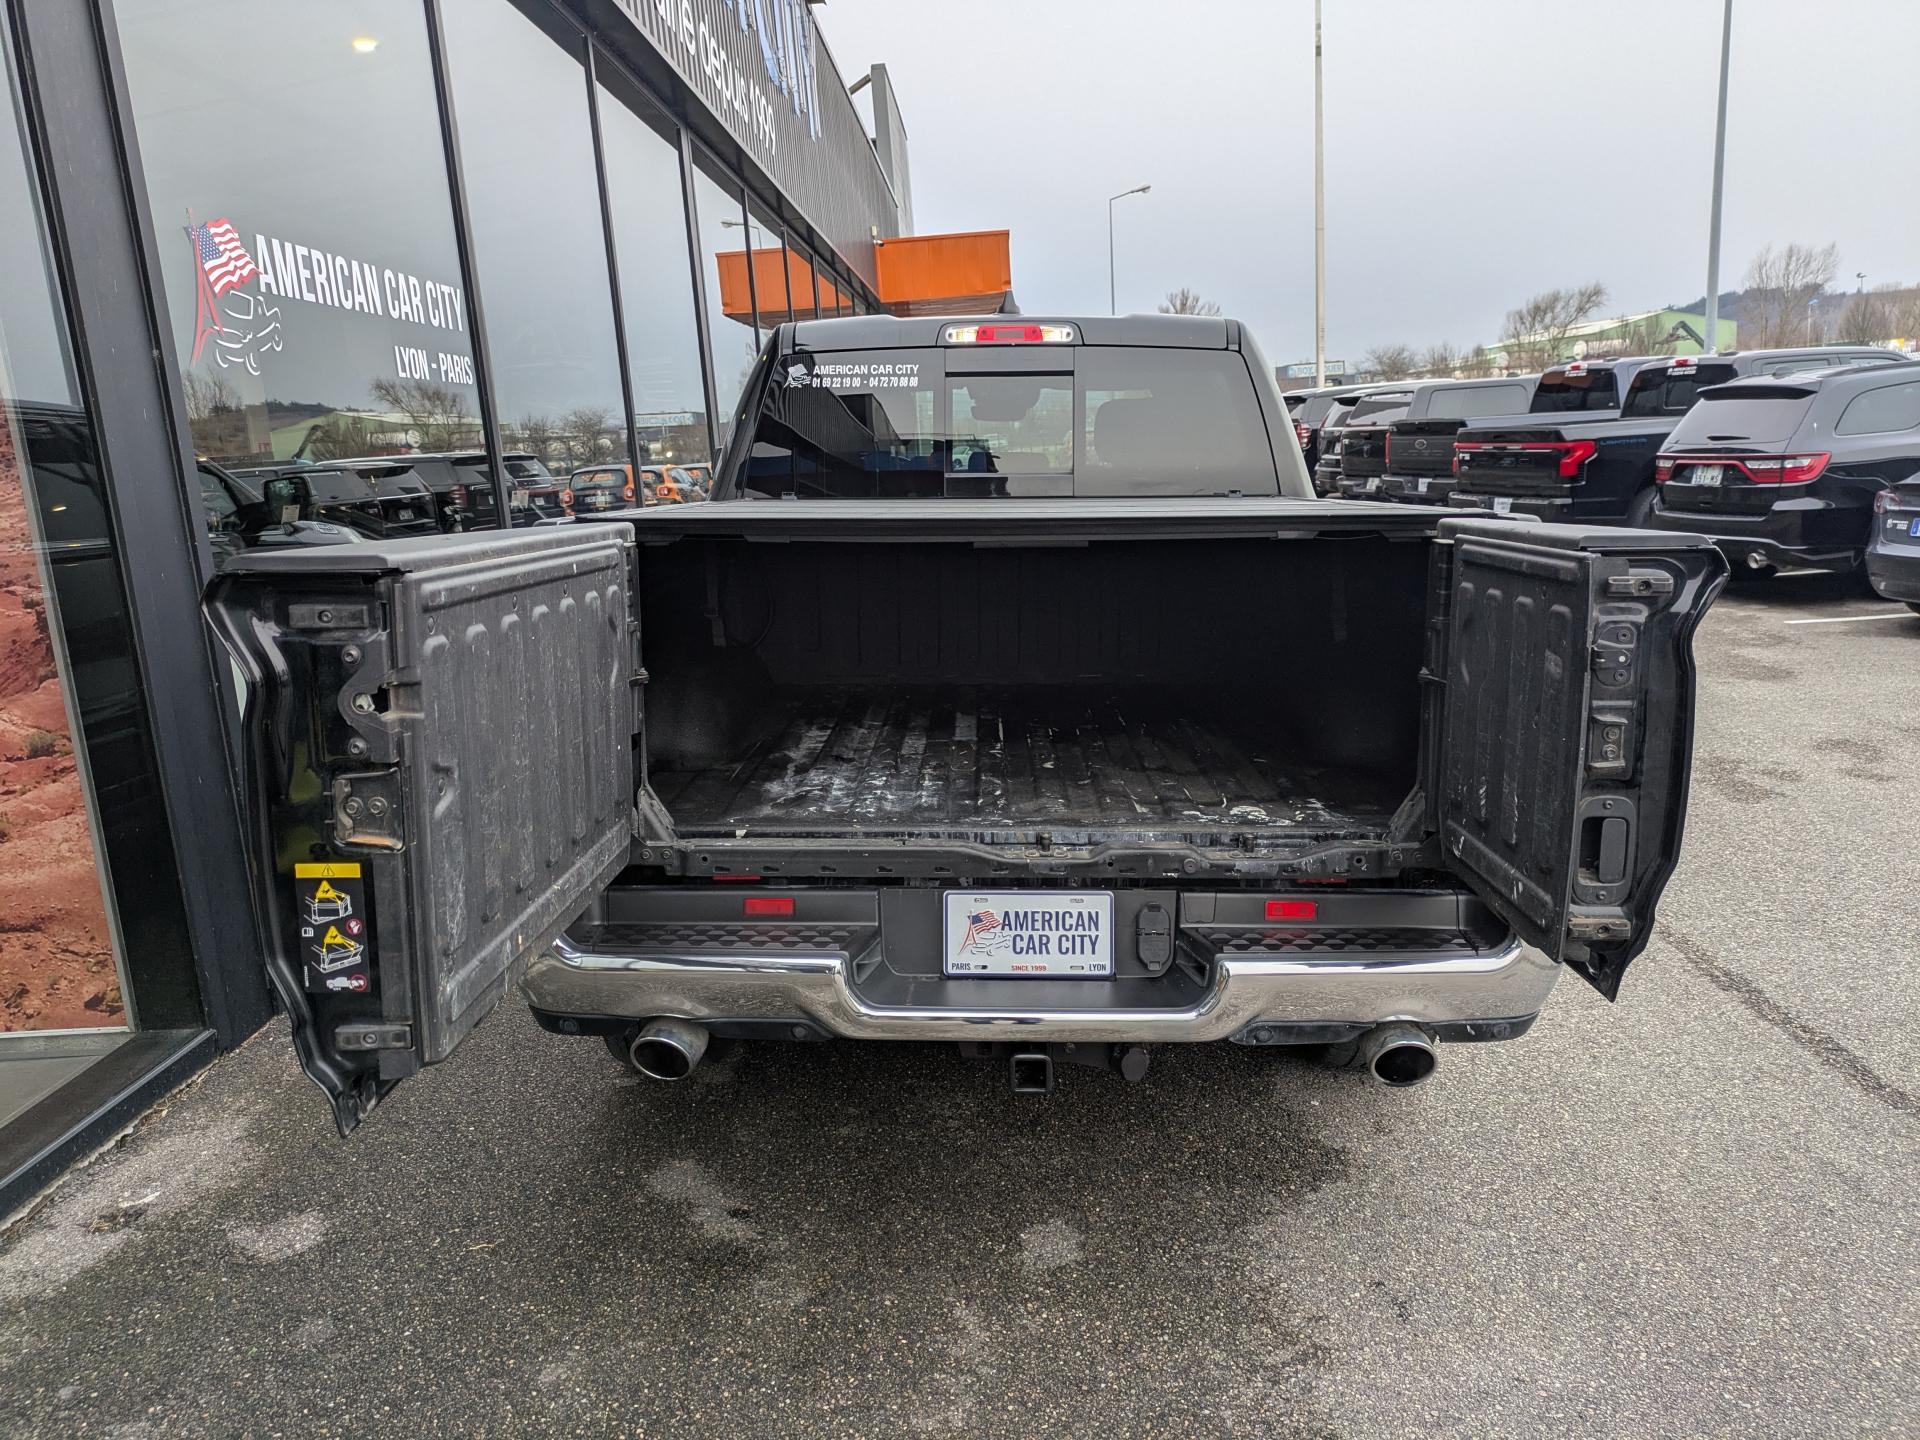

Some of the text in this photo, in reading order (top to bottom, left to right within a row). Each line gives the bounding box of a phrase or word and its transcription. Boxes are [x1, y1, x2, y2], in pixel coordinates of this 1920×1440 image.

[699, 13, 749, 124] depuis
[750, 79, 776, 156] 1999
[255, 234, 464, 332] AMERICAN CAR CITY
[394, 345, 430, 380] LYON
[438, 353, 474, 385] PARIS
[812, 364, 919, 375] AMERICAN CAR CITY
[812, 377, 821, 388] 01
[832, 377, 841, 388] 22
[879, 377, 888, 388] 72
[1001, 910, 1100, 932] AMERICAN
[1012, 934, 1100, 956] CAR CITY
[951, 962, 972, 971] PARIS
[1089, 962, 1107, 971] LYON
